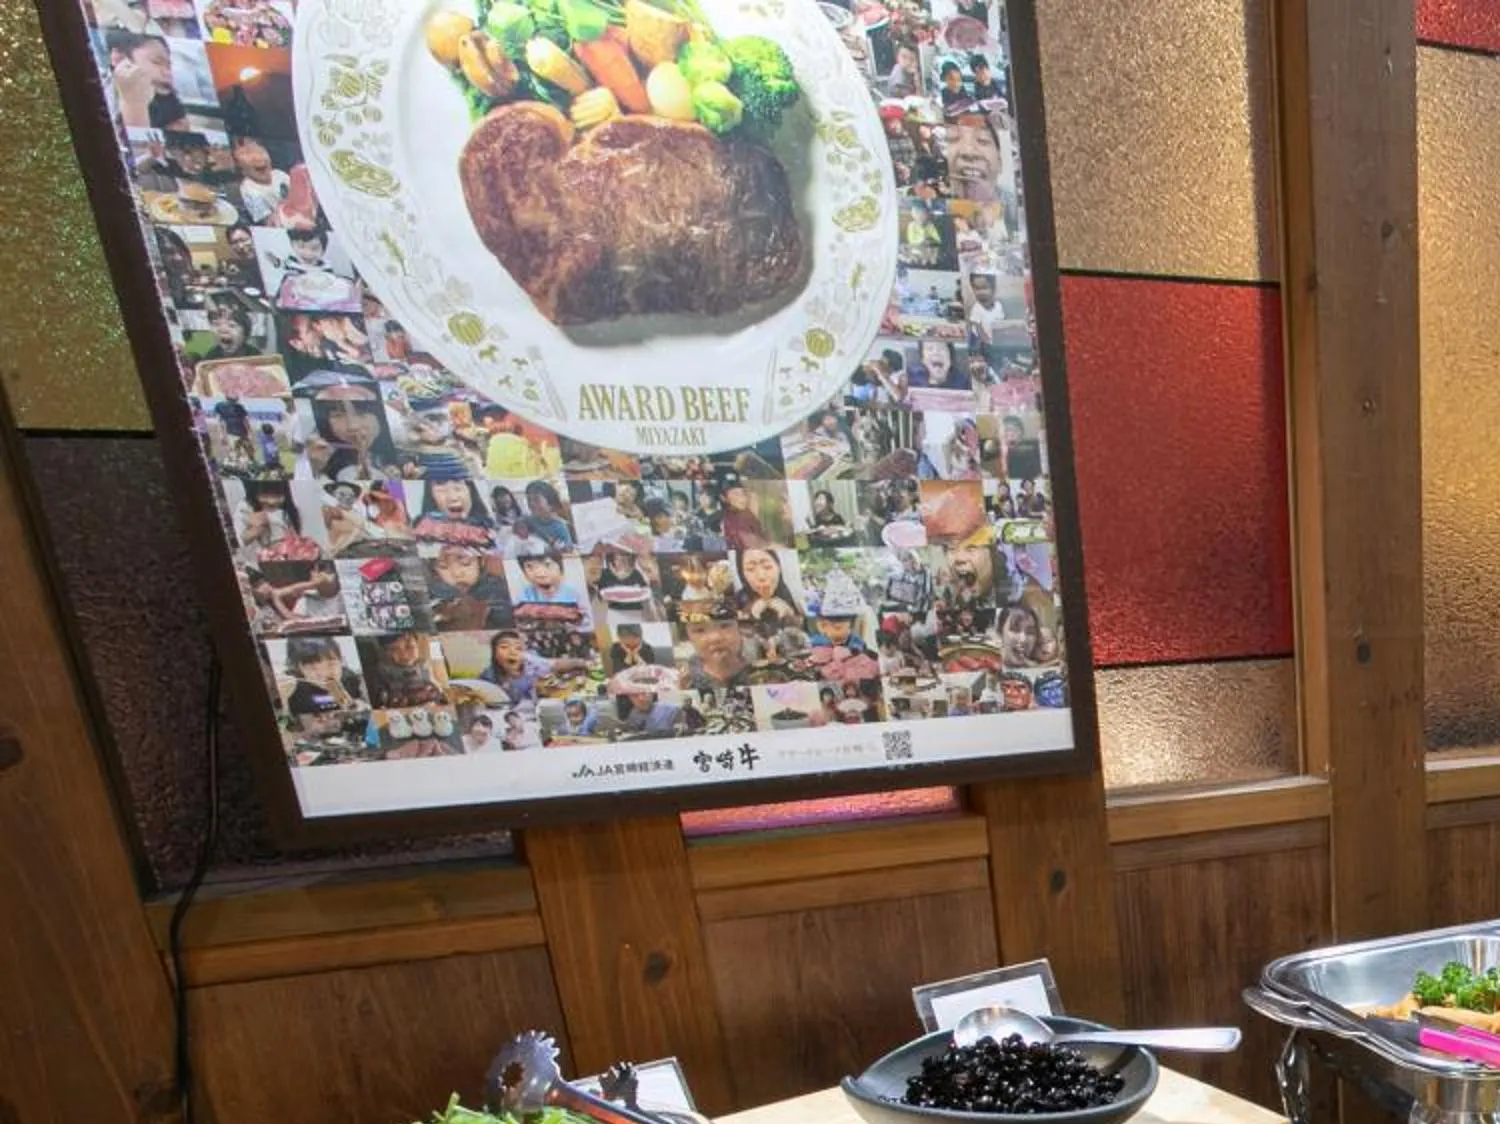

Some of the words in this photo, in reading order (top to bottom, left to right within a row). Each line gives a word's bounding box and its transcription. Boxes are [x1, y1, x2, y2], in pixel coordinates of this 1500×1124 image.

[578, 383, 675, 421] AWARD
[681, 385, 751, 423] BEEF
[636, 426, 707, 447] MIYAZAKI
[693, 743, 761, 773] 宮崎牛
